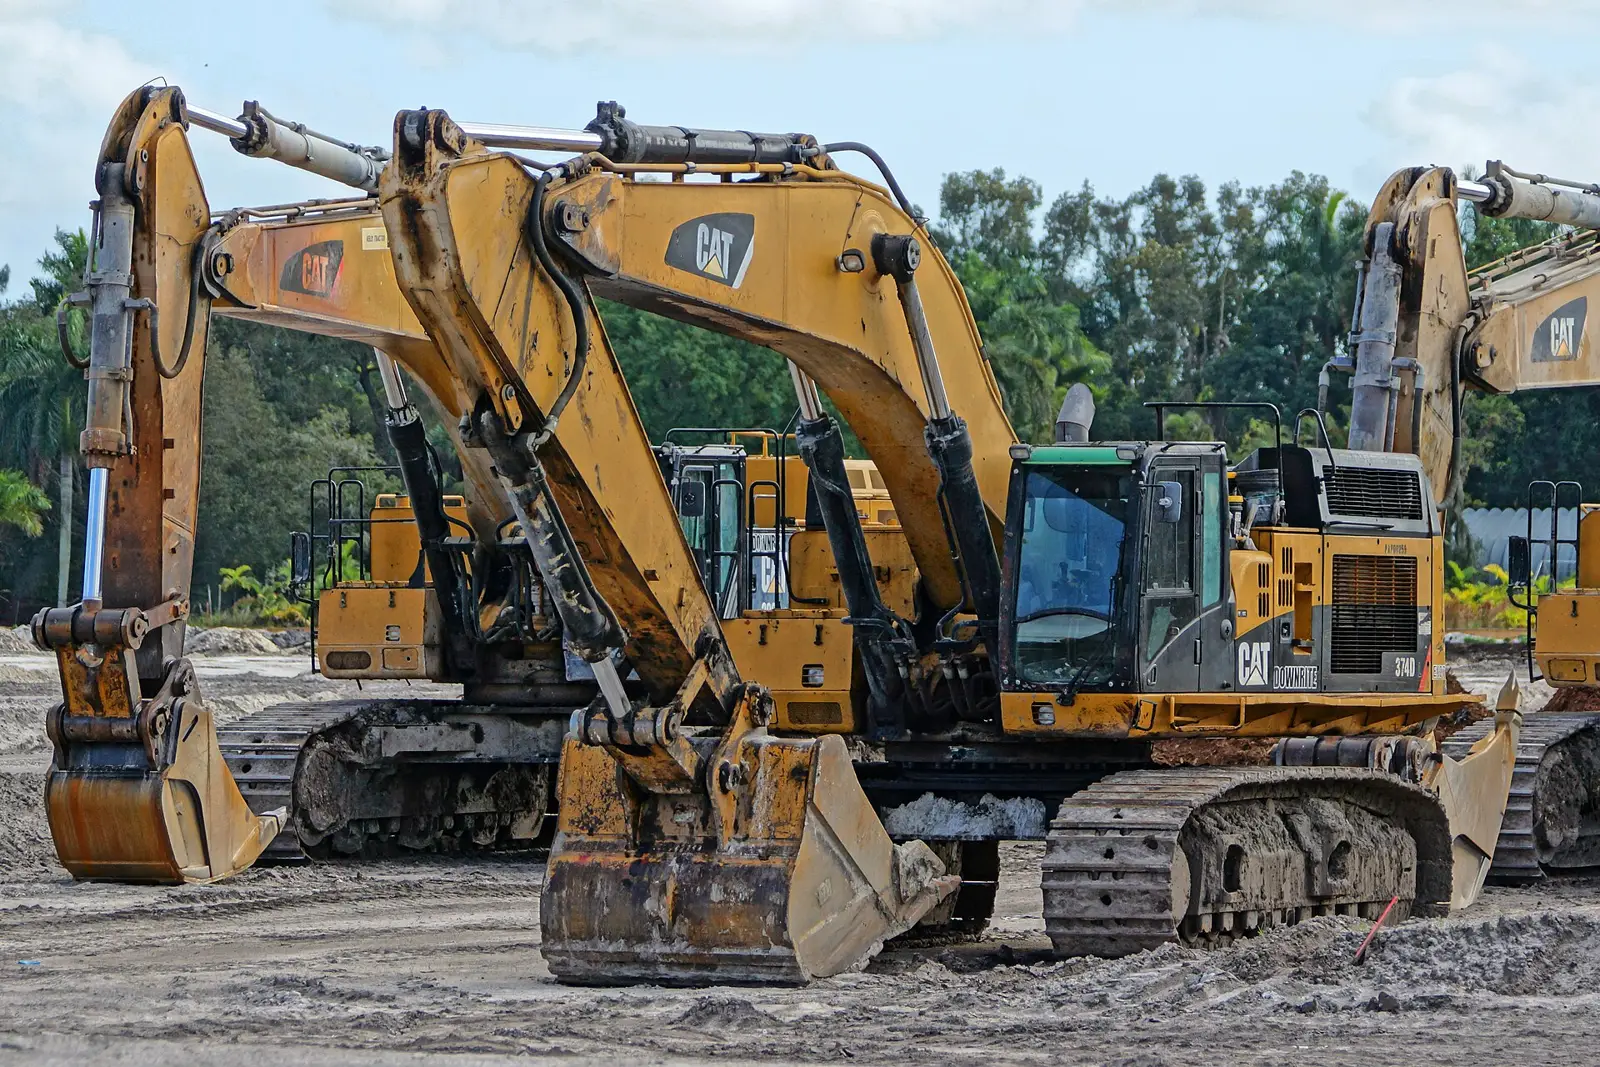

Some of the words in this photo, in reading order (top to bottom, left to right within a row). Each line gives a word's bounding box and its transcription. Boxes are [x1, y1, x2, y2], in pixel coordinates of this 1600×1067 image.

[696, 222, 735, 279] CAT
[302, 252, 329, 293] CAT
[1550, 317, 1575, 357] CAT
[752, 533, 783, 552] DOWNR
[1238, 641, 1270, 686] CAT
[1273, 665, 1318, 689] DOWNRITE
[1395, 656, 1415, 677] 374D
